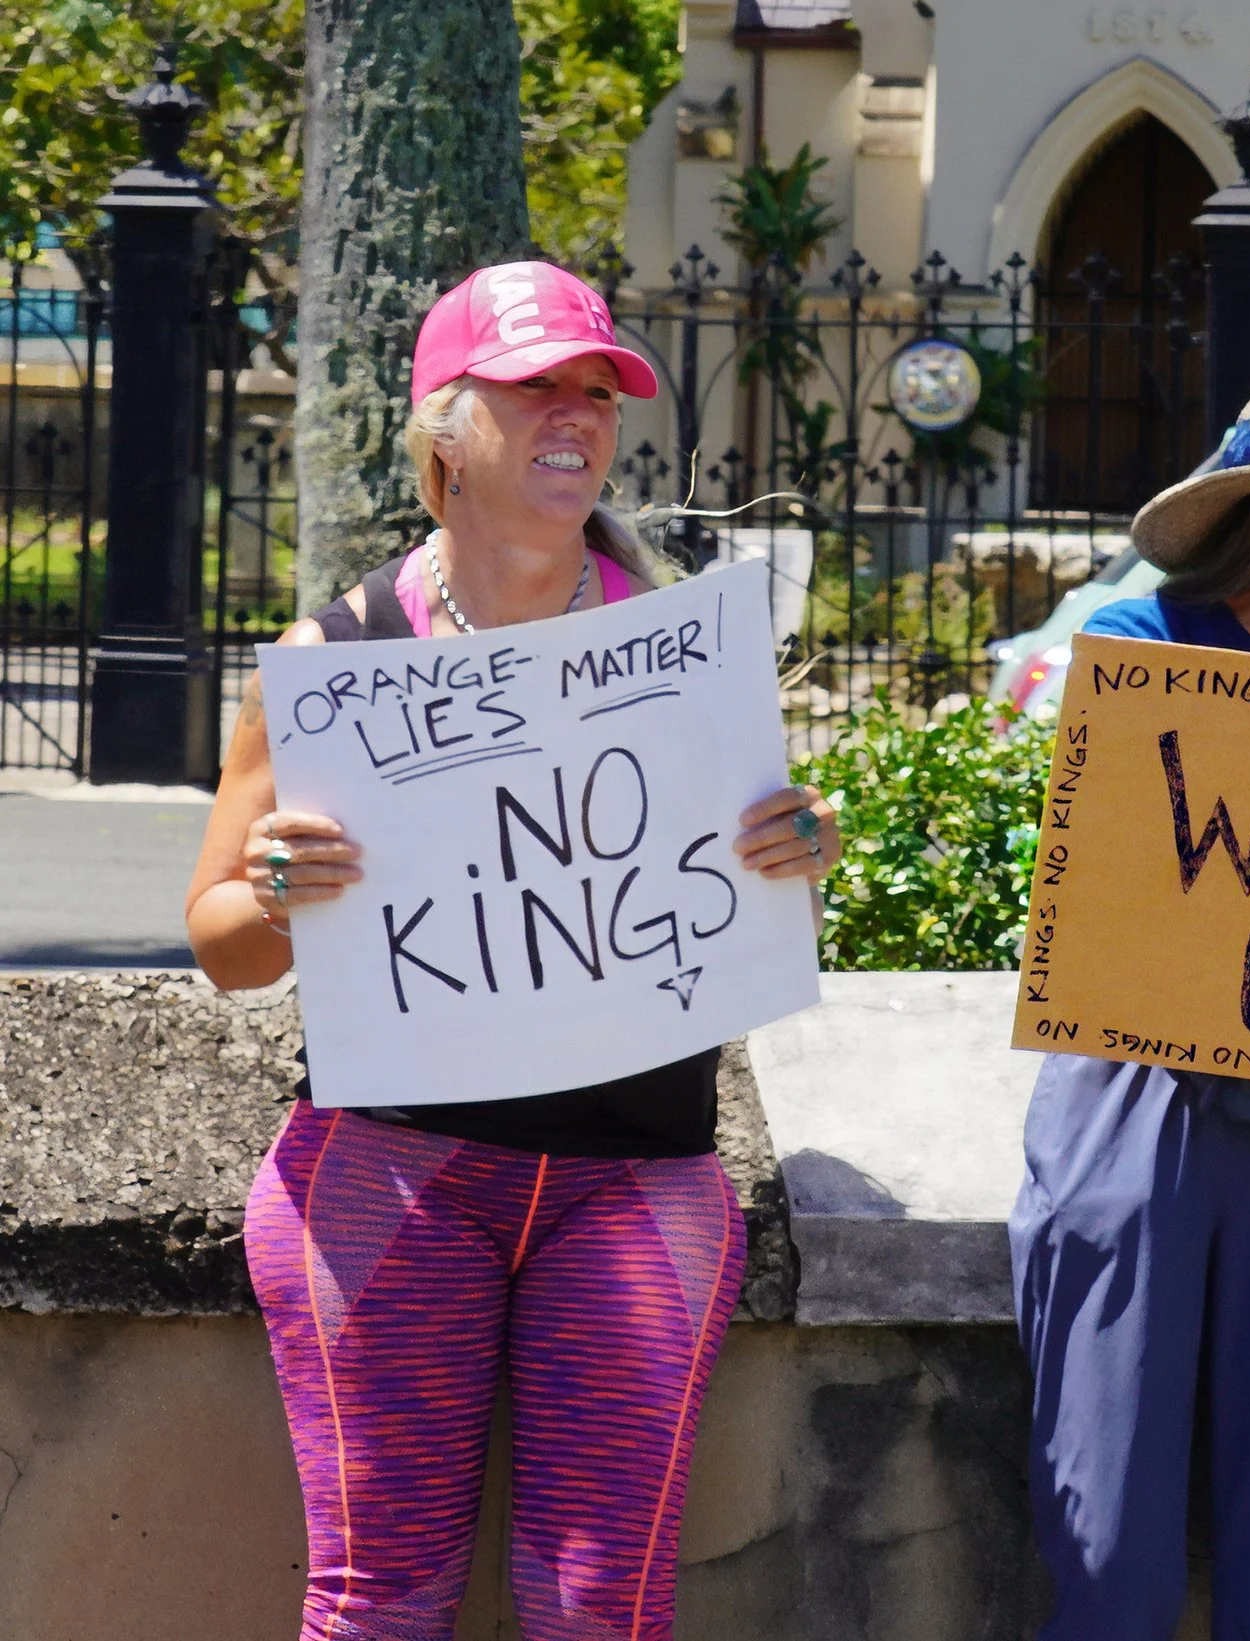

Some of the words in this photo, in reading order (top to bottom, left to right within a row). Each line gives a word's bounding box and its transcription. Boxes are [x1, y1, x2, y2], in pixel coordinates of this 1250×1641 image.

[562, 593, 722, 697] MATTER!
[1093, 663, 1149, 695] NO
[354, 692, 526, 768] LIES
[496, 748, 647, 882] NO
[1044, 845, 1068, 885] NO
[383, 832, 737, 1013] KINGS
[1036, 1019, 1078, 1040] NO
